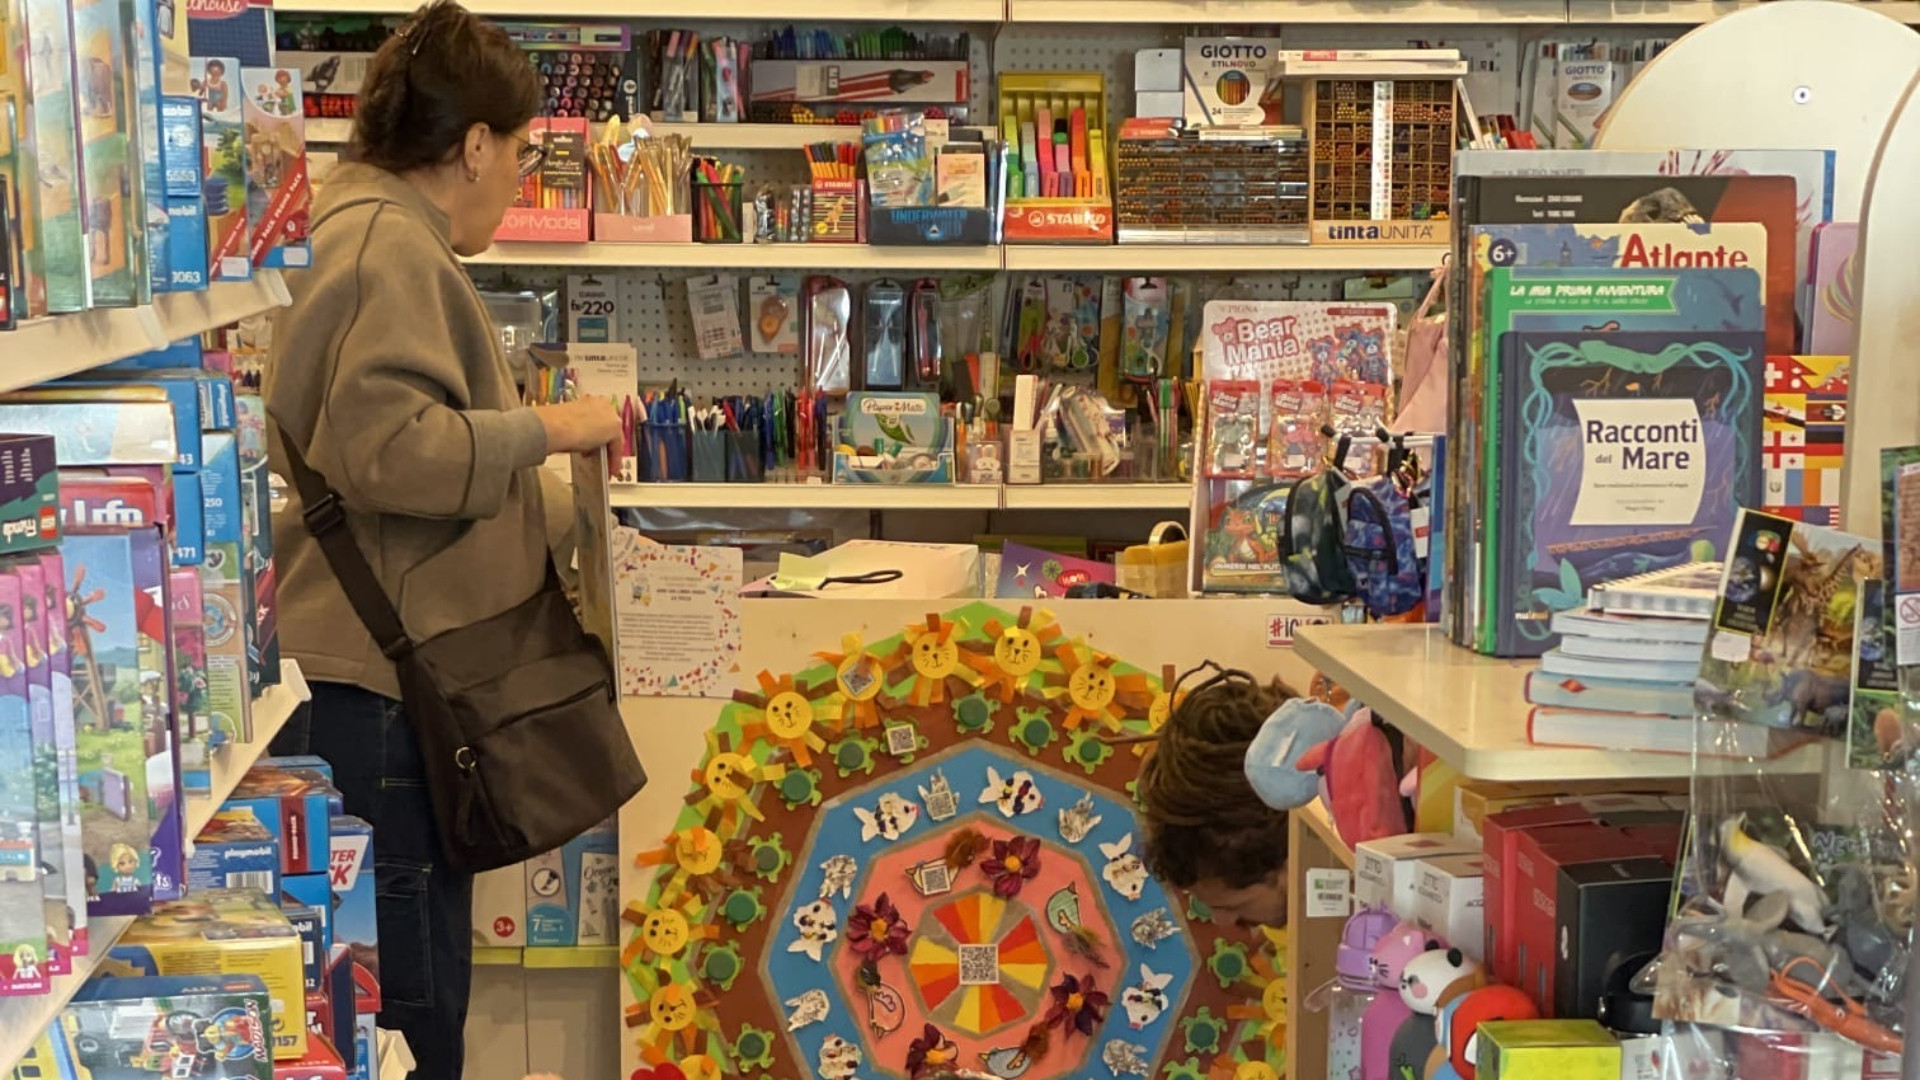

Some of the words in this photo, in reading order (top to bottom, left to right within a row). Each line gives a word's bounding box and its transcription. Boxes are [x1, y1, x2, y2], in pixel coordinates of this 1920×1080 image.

[1201, 45, 1267, 59] GIOTTO
[1565, 65, 1605, 75] GIOTTO
[1493, 246, 1515, 261] 6+
[1621, 234, 1748, 267] Atlante
[1237, 318, 1297, 343] Bear
[1227, 339, 1299, 364] Mania
[1586, 419, 1698, 443] Racconti
[1595, 454, 1612, 463] del
[1622, 446, 1690, 469] Mare
[224, 847, 272, 859] playmobil
[496, 920, 512, 932] 3+
[532, 918, 541, 932] 7
